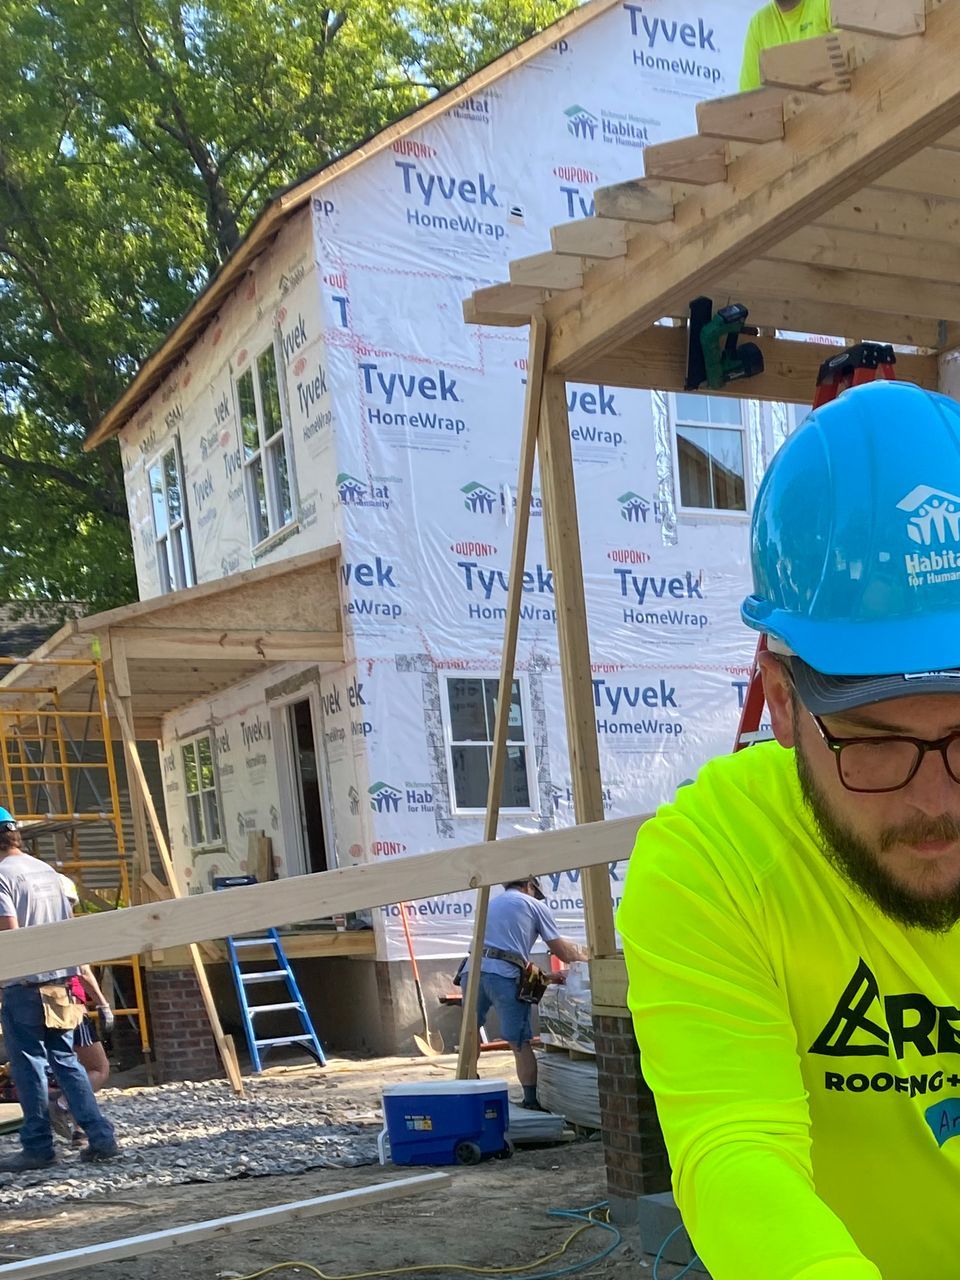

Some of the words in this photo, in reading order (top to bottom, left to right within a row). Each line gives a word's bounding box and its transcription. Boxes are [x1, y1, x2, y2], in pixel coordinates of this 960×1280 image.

[623, 3, 716, 52] Tyvek
[633, 50, 721, 83] HomeWrap
[601, 118, 648, 141] Habitat
[395, 160, 499, 206] Tyvek
[558, 166, 595, 184] DUPONT
[406, 207, 505, 240] HomeWrap
[282, 312, 308, 366] yvek
[297, 364, 328, 418] Tyvek
[358, 363, 460, 404] Tyvek
[567, 385, 617, 416] vek
[367, 407, 466, 435] HomeWrap
[571, 426, 623, 447] eWrap
[455, 542, 492, 558] DUPONT
[612, 550, 647, 565] DUPONT
[340, 557, 396, 588] vek
[613, 568, 704, 606] Tyvek
[908, 574, 924, 587] for
[346, 599, 402, 619] eWrap
[623, 608, 708, 629] HomeWrap
[592, 679, 679, 715] Tyvek
[240, 714, 264, 752] Tyvek
[597, 719, 683, 737] HomeWrap
